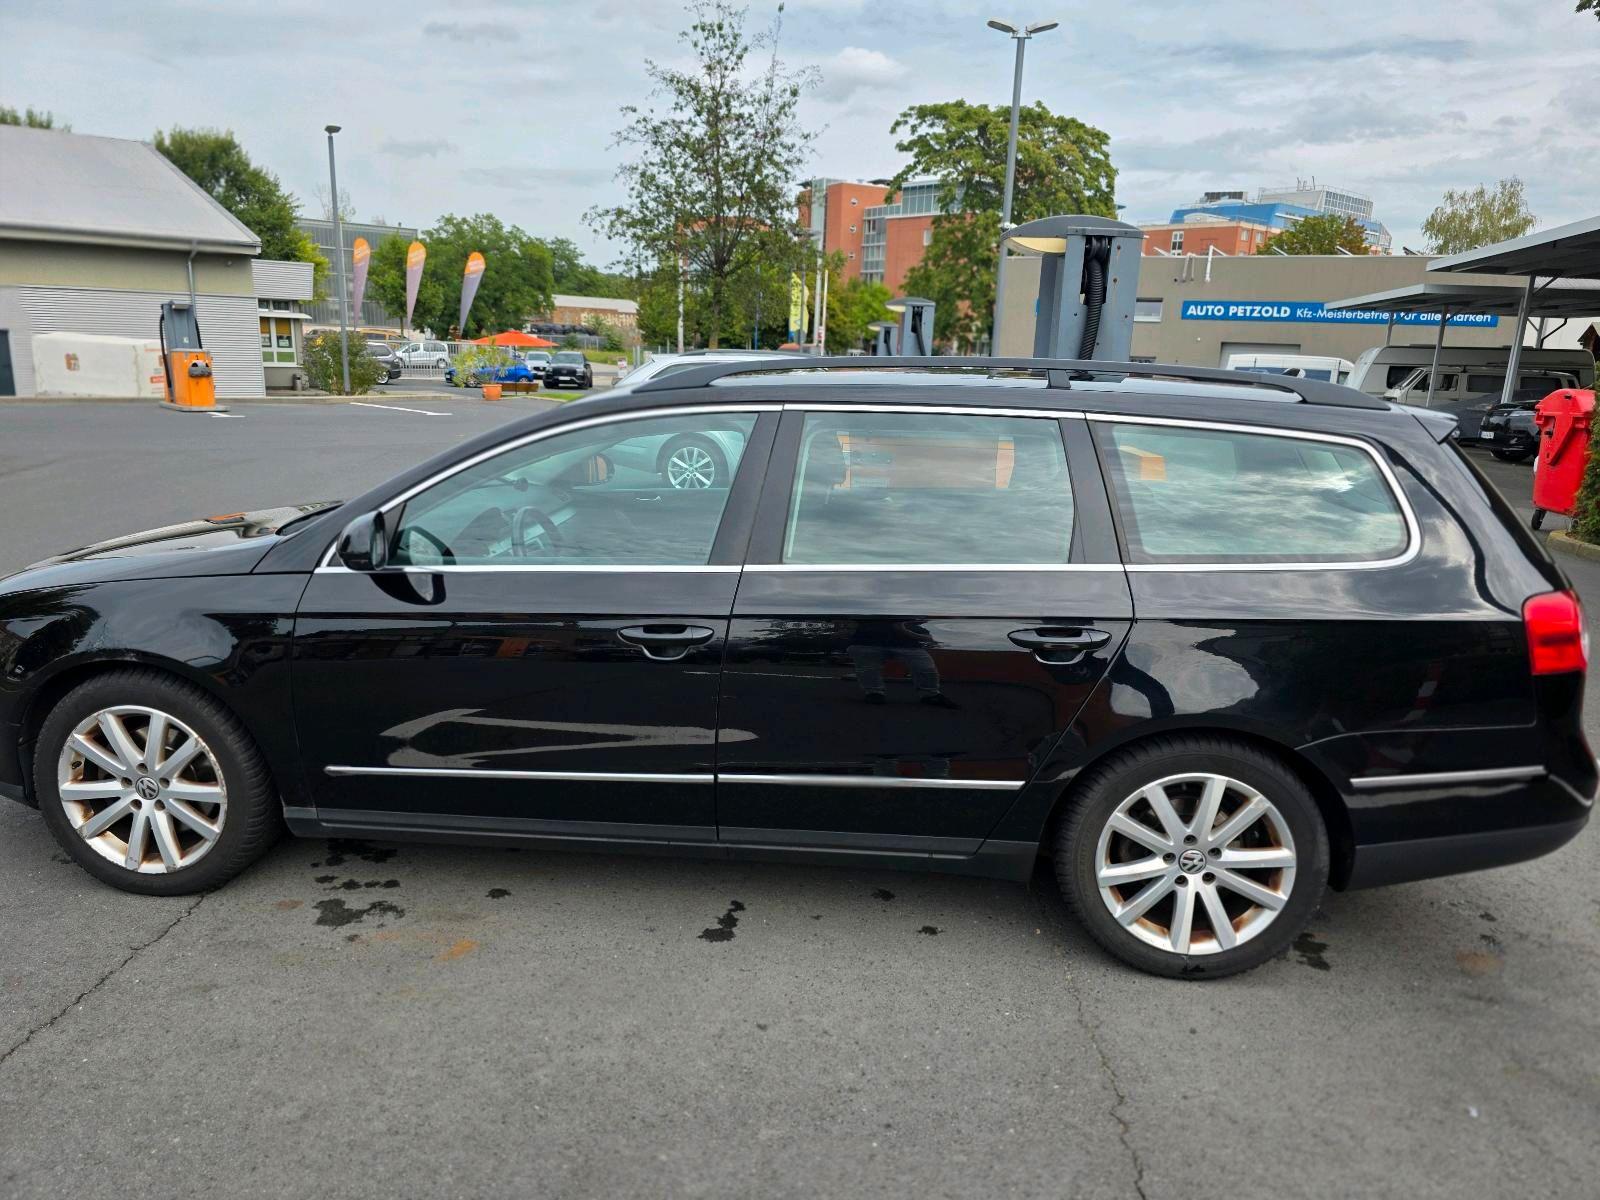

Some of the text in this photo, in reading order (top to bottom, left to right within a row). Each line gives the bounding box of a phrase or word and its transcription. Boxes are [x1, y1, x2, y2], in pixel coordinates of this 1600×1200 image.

[1187, 304, 1224, 316] AUTO
[1229, 305, 1291, 318] PETZOLD
[1419, 312, 1441, 321] alle
